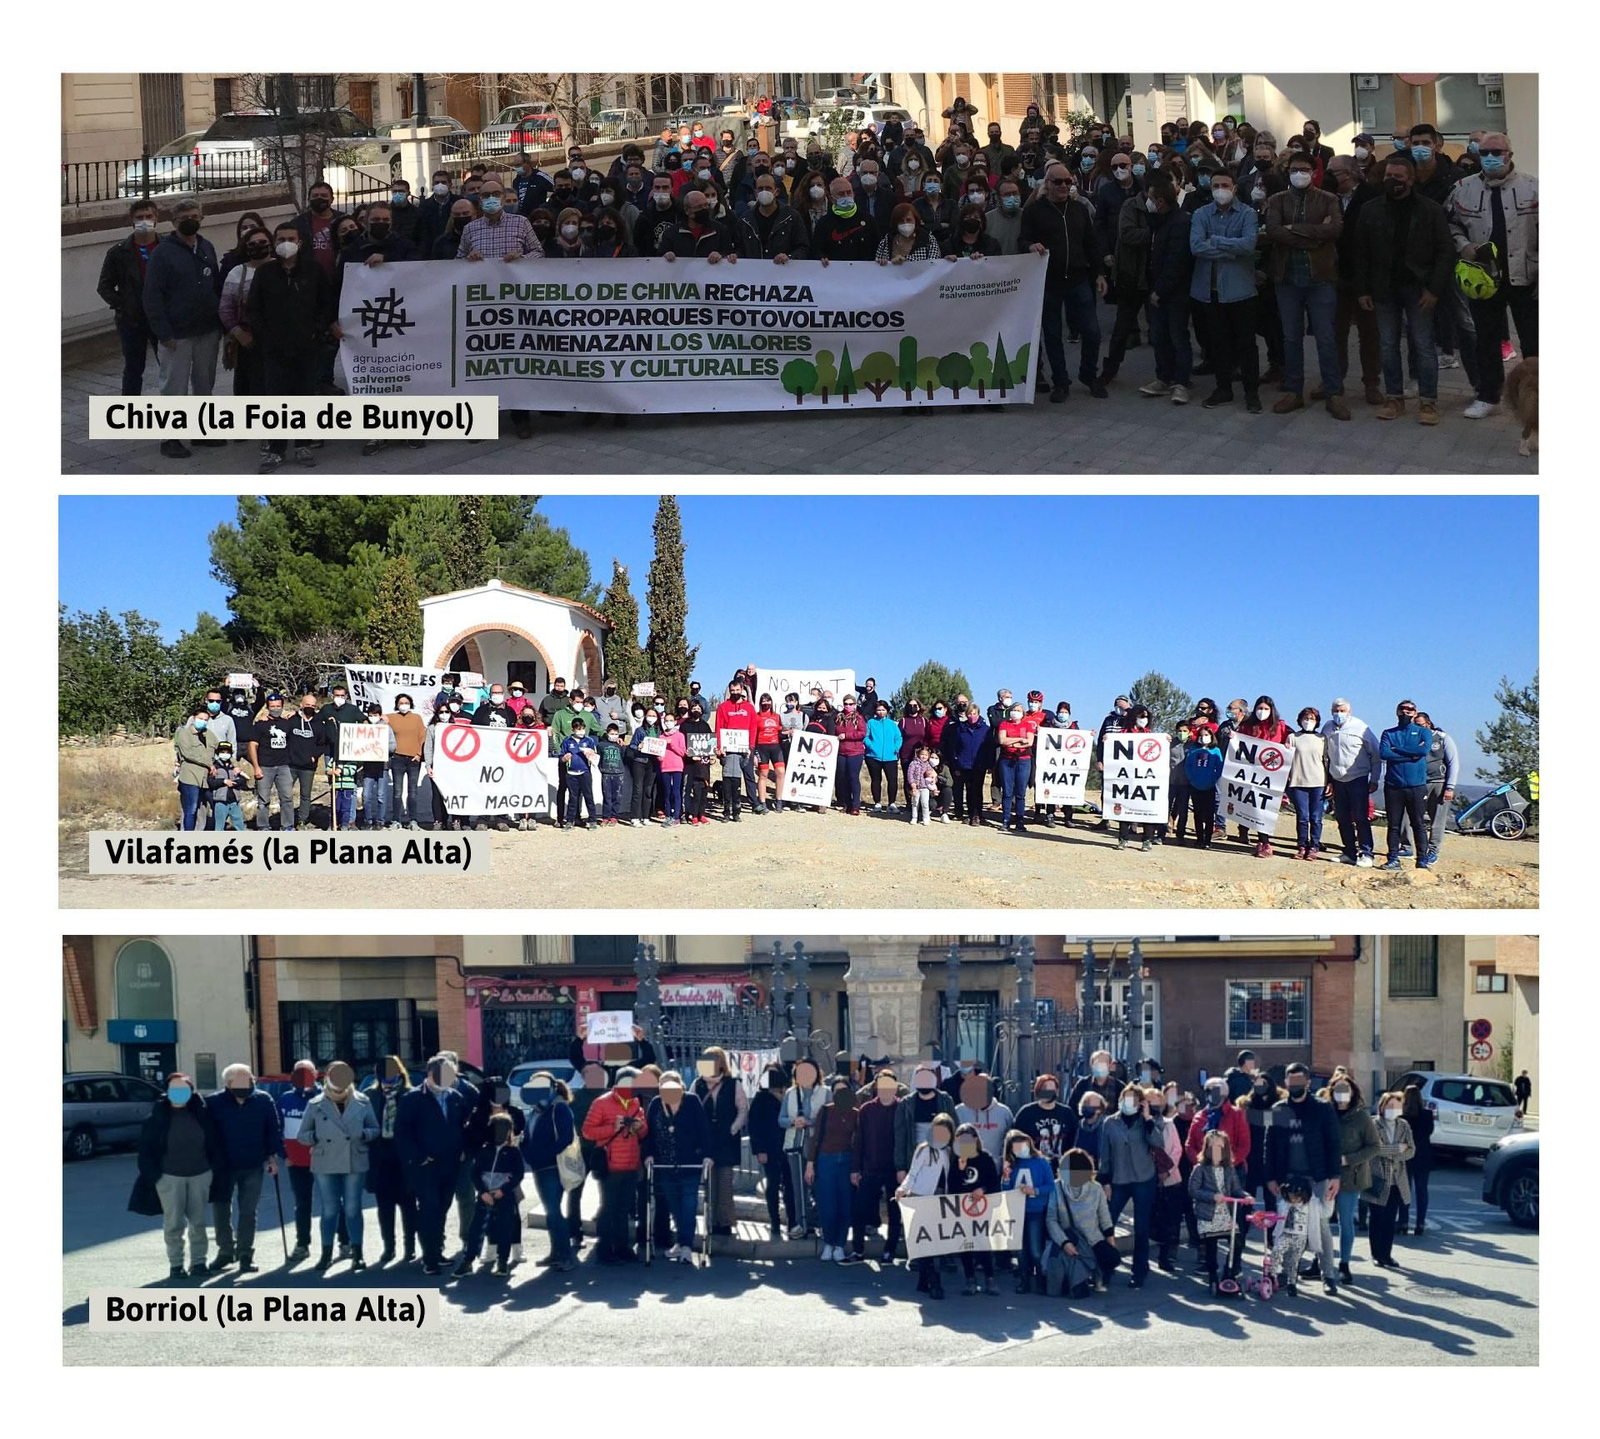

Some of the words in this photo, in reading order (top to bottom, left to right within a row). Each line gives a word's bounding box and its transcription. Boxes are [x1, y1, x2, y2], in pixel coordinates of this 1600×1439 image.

[466, 283, 495, 302] EL
[500, 283, 593, 301] PUEBLO
[597, 283, 628, 301] DE
[631, 283, 700, 301] CHIVA
[704, 283, 814, 303] RECHAZA
[466, 307, 514, 327] LOS
[518, 308, 713, 327] MACROPARQUES
[717, 308, 905, 329] FOTOVOLTAICOS
[465, 333, 515, 353] QUE
[519, 333, 653, 352] AMENAZAN
[657, 333, 703, 351] LOS
[707, 333, 812, 351] VALORES
[353, 352, 415, 364] agrupación
[352, 364, 367, 373] de
[369, 361, 443, 373] asociaciones
[465, 358, 605, 378] NATURALES
[609, 359, 627, 378] Y
[630, 357, 779, 377] CULTURALES
[352, 374, 411, 384] salvemos
[352, 384, 403, 395] brihuela
[349, 669, 437, 687] RENOVABLES
[769, 676, 790, 692] NO
[356, 726, 386, 739] MAT
[692, 740, 709, 749] NO
[479, 765, 505, 783] NO
[791, 771, 828, 788] MAT
[1042, 771, 1081, 786] MAT
[1117, 766, 1129, 779] A
[1134, 767, 1156, 779] LA
[1234, 768, 1246, 781] A
[1250, 772, 1271, 789] LA
[1112, 783, 1160, 801] MAT
[1227, 782, 1274, 811] MAT
[485, 794, 546, 810] MAGDA
[1014, 1168, 1035, 1197] A
[915, 1226, 932, 1244] A
[938, 1221, 966, 1240] LA
[972, 1219, 1016, 1237] MAT
